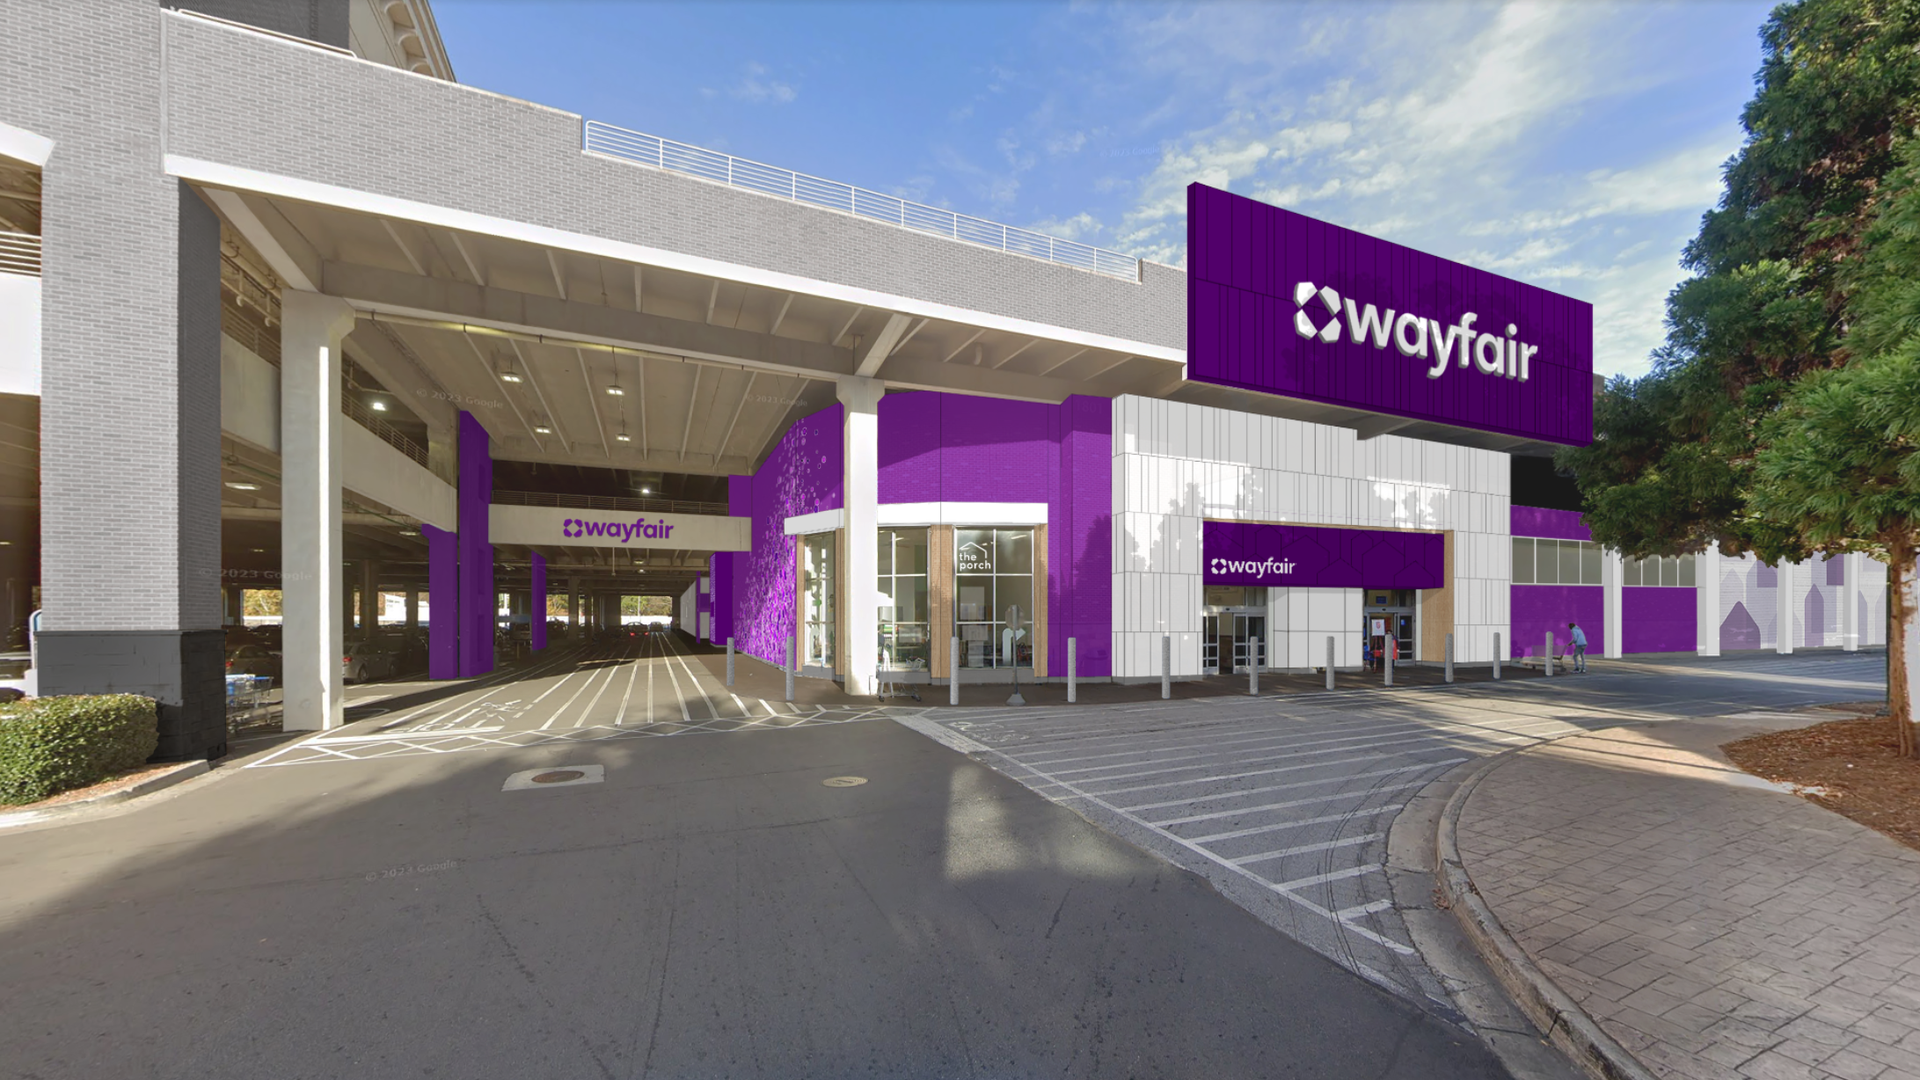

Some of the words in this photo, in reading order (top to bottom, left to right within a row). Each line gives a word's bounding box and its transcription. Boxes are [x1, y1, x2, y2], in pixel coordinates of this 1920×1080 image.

[1343, 297, 1538, 383] wayfair
[584, 518, 674, 543] wayfair
[959, 552, 977, 561] the
[960, 560, 991, 572] porch
[1228, 556, 1296, 579] wayfair
